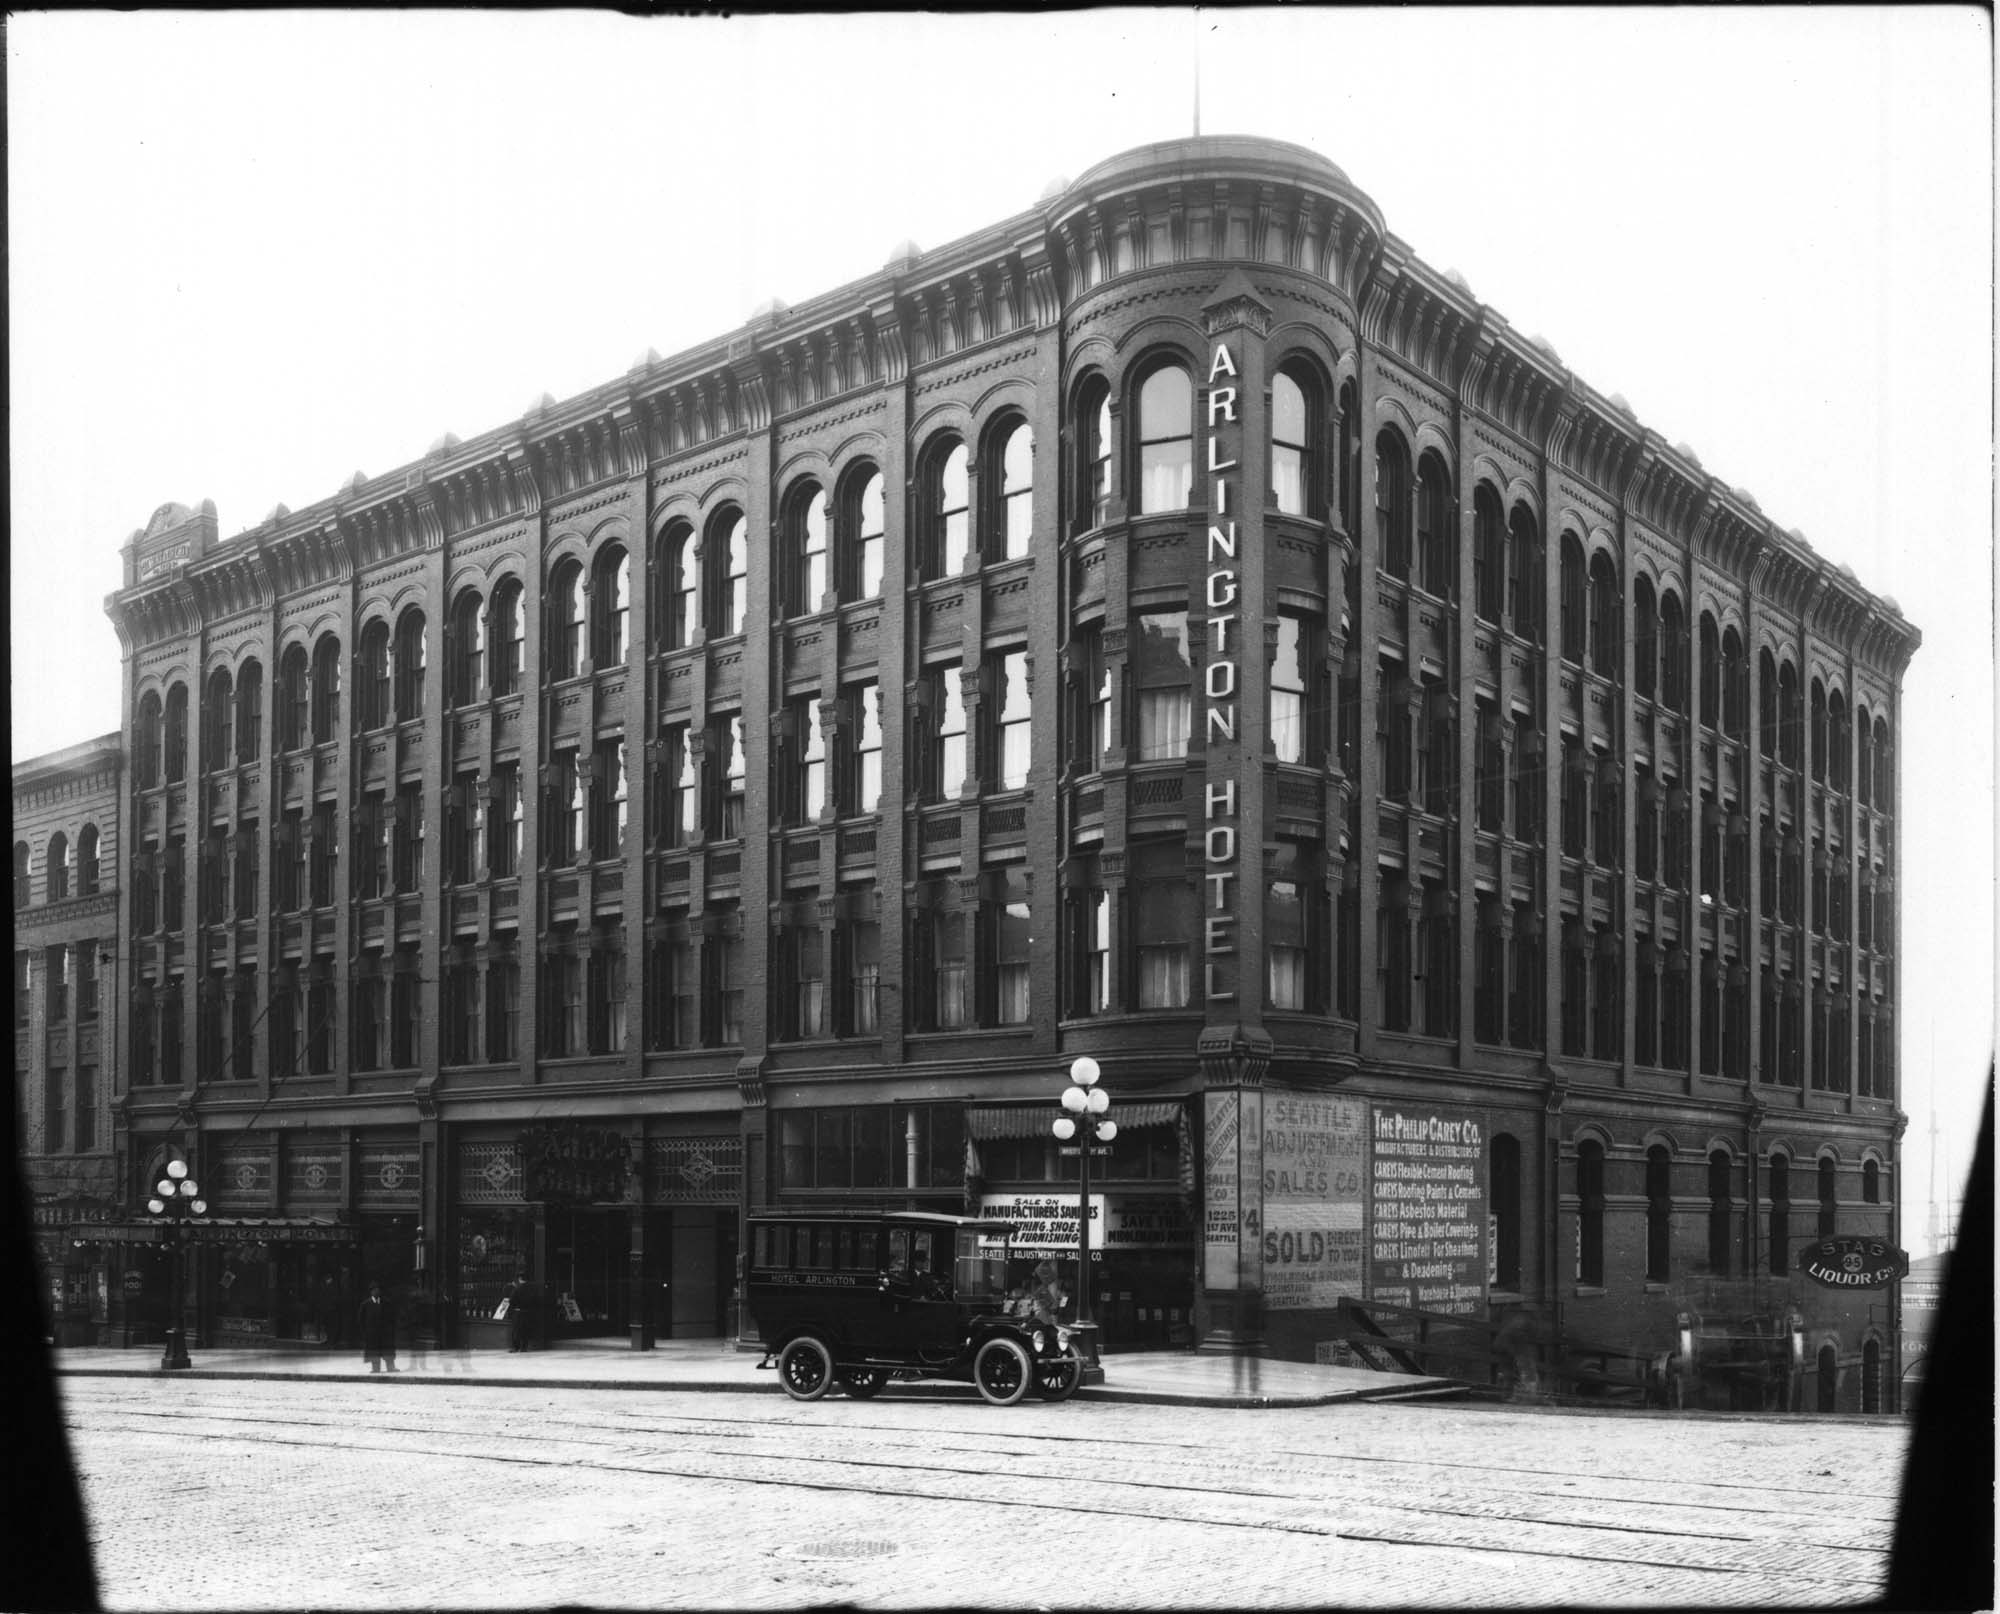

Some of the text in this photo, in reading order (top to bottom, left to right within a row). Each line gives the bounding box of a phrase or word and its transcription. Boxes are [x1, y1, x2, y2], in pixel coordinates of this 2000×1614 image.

[1205, 343, 1237, 1000] ARLINGTON HOTEL
[1274, 1100, 1356, 1129] SEATTLE
[1373, 1109, 1394, 1138] THE
[1395, 1113, 1428, 1140] PHILIP
[1428, 1116, 1461, 1142] CAREY
[1206, 1173, 1239, 1186] SALES
[1264, 1169, 1330, 1194] SALES
[1397, 1162, 1421, 1178] Flexible
[1422, 1163, 1446, 1179] Cement
[1447, 1164, 1473, 1184] Roofing
[1398, 1181, 1425, 1202] Roofing
[1426, 1183, 1447, 1198] Paints
[1454, 1183, 1480, 1198] Cements
[1014, 1198, 1041, 1206] SALE
[1399, 1202, 1435, 1219] Asbestos
[1437, 1202, 1468, 1218] Material
[983, 1205, 1059, 1219] MANUFACTURERS
[1060, 1205, 1098, 1219] SAMES
[1208, 1211, 1236, 1221] 1225
[1221, 1223, 1238, 1232] AVE
[1399, 1222, 1416, 1239] Pipe
[1423, 1222, 1445, 1239] Boiler
[1445, 1222, 1479, 1240] Coverings
[1206, 1234, 1237, 1243] SEATTLE
[1013, 1250, 1056, 1260] ADJUSTMENT
[1264, 1231, 1325, 1264] SOLD
[1822, 1240, 1886, 1257] STAG
[1845, 1256, 1861, 1268] 95
[771, 1273, 856, 1285] HOTEL ARLINGTON
